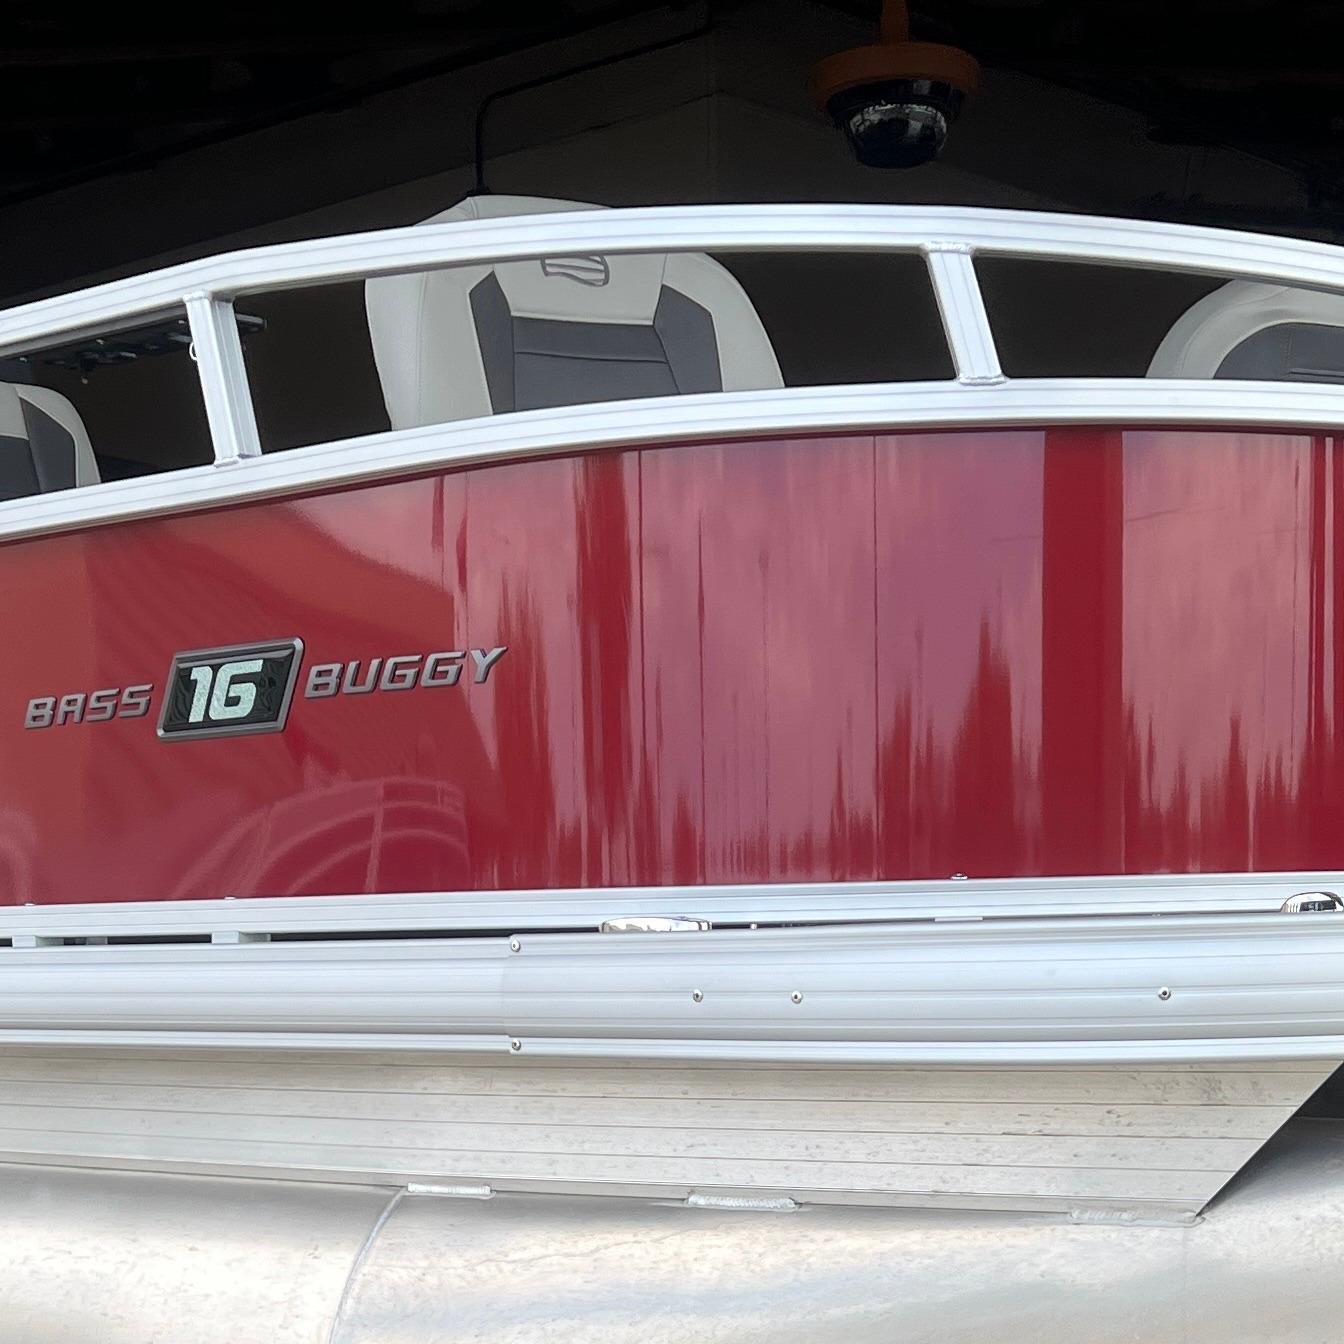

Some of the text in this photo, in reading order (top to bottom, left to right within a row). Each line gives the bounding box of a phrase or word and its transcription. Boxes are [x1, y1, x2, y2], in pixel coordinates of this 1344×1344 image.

[24, 646, 508, 729] BASS 16 BUGGY
